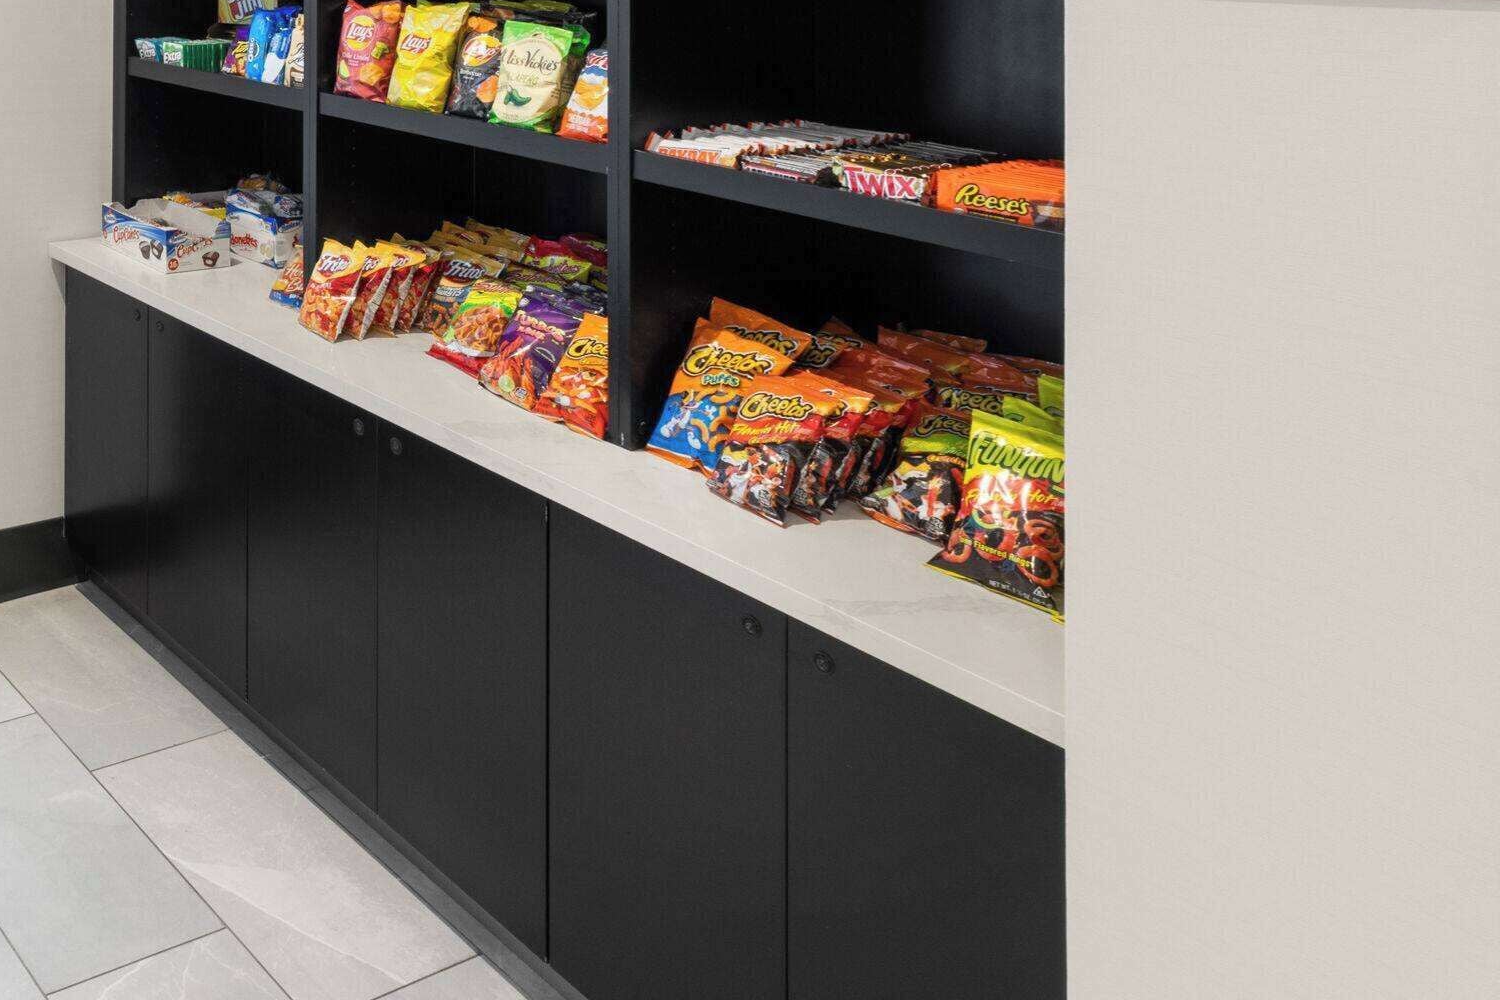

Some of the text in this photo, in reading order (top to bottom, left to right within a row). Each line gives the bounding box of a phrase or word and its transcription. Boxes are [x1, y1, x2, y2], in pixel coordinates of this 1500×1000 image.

[347, 22, 375, 41] Lay's
[401, 33, 431, 55] Lay's
[163, 51, 182, 61] Extra
[525, 49, 558, 74] Vickie's
[955, 184, 1030, 215] Reese's
[443, 259, 486, 279] Fritos
[568, 338, 608, 359] Chee
[683, 342, 774, 377] Cheetos
[739, 392, 815, 421] Cheetos
[940, 387, 1003, 415] Cheeto
[968, 431, 1065, 484] FUNYUN
